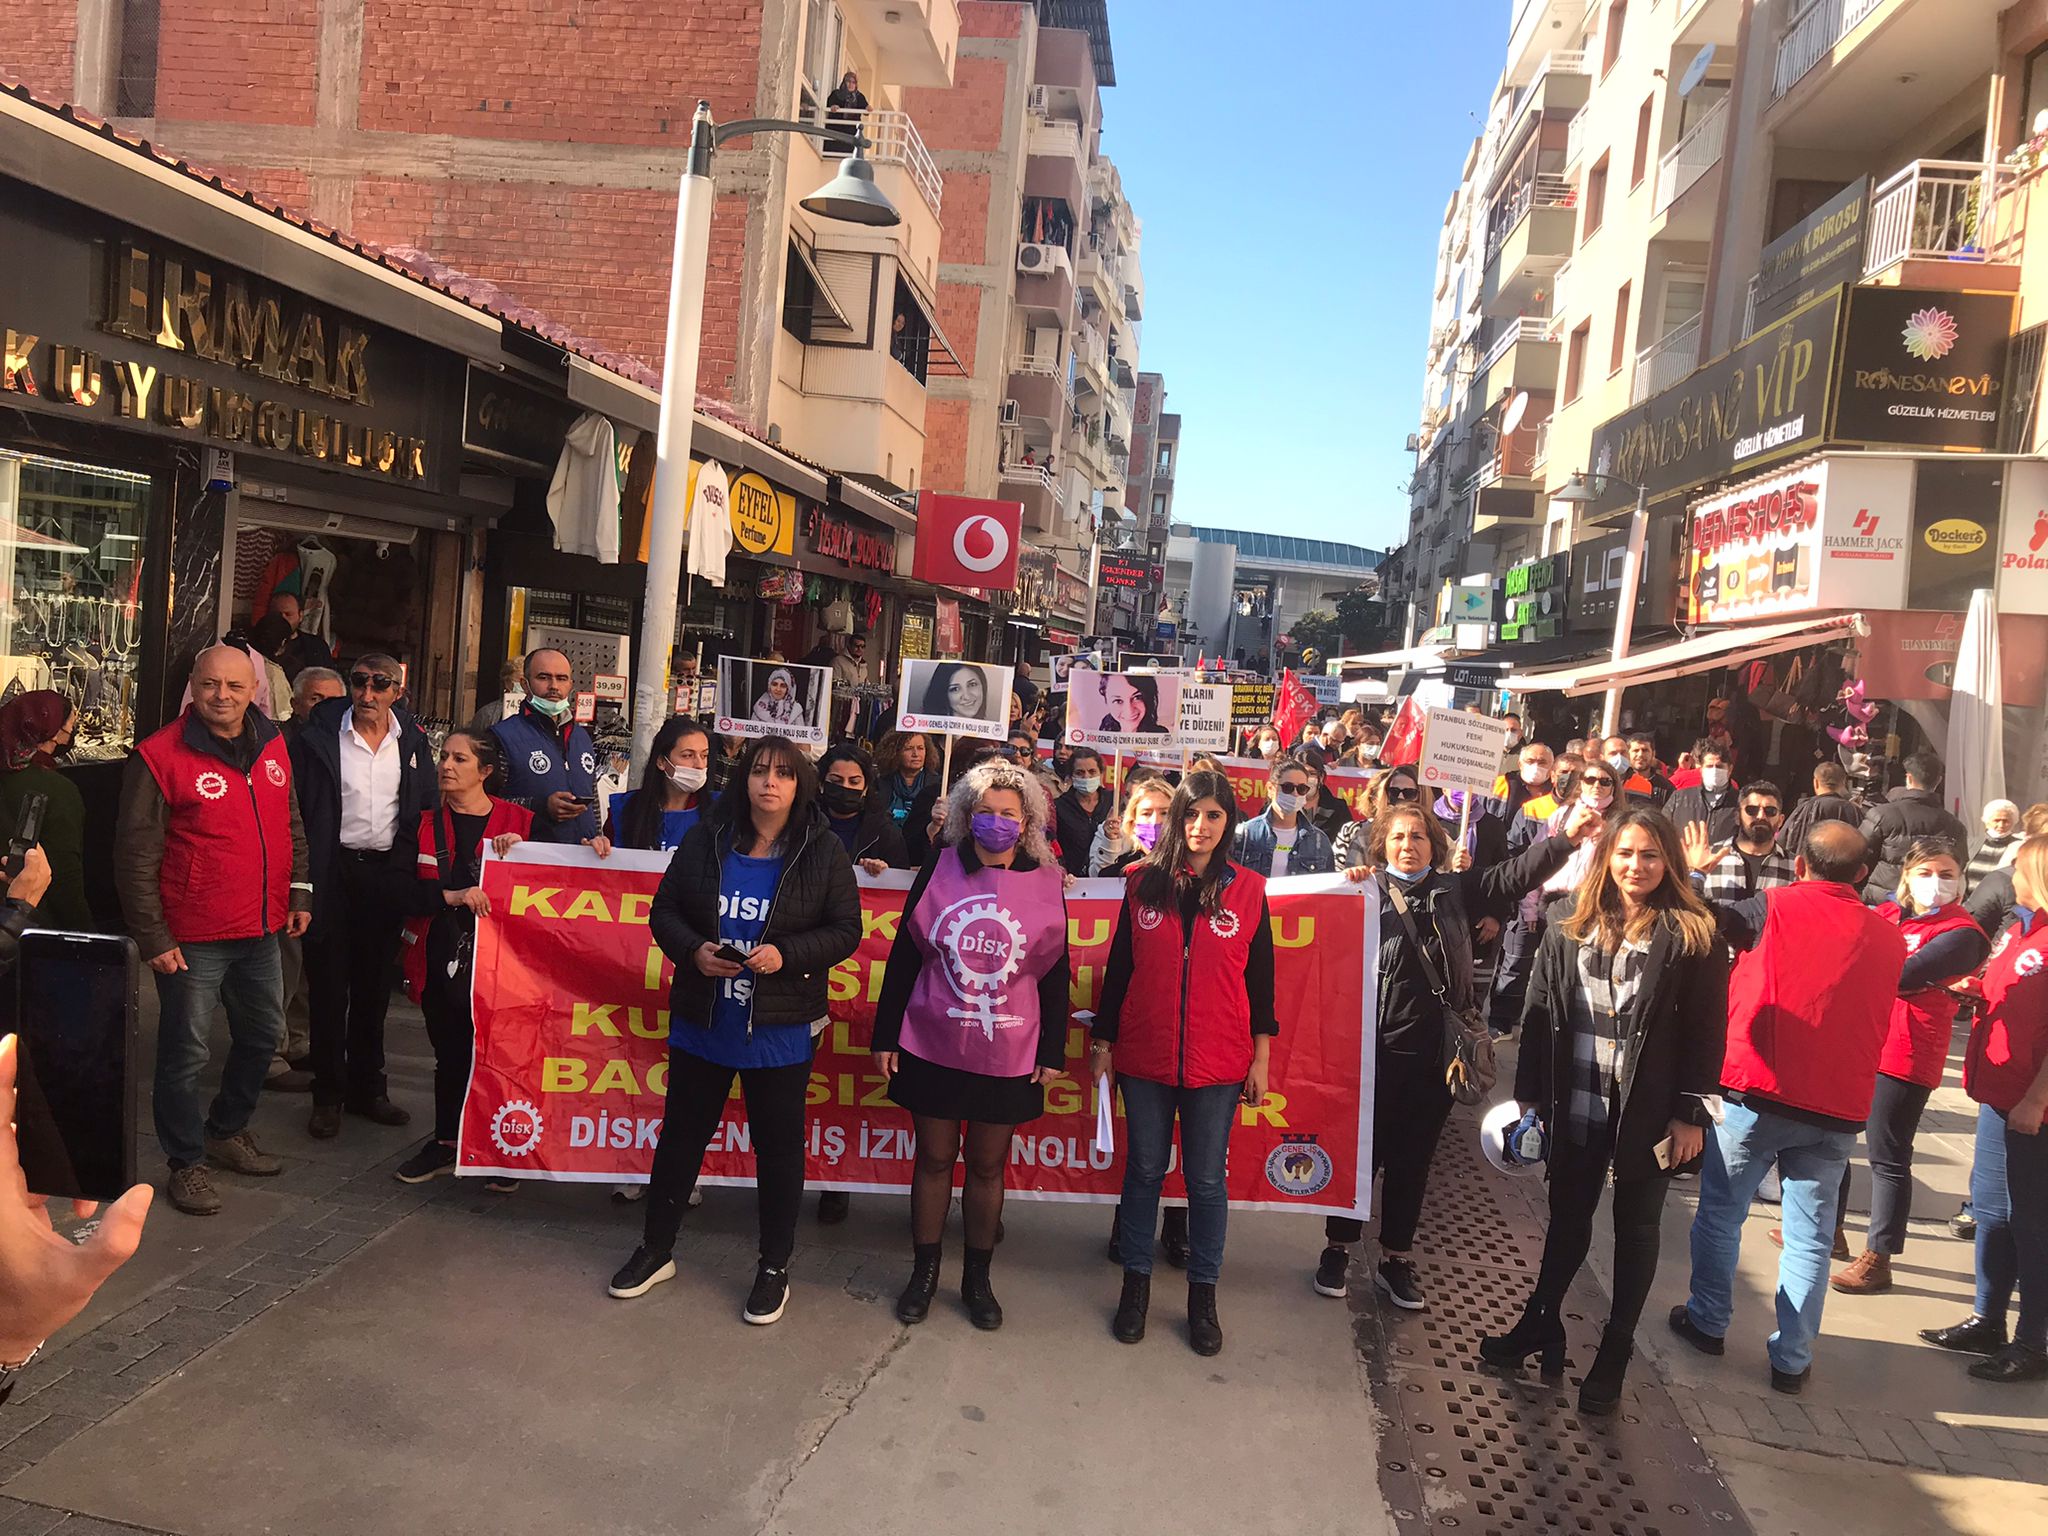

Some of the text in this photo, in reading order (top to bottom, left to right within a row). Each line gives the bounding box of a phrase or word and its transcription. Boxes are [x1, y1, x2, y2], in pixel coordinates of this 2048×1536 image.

[1812, 197, 1861, 250] BÜROSU
[1888, 404, 1996, 422] GÜZELLİK HİZMETLERİ
[738, 482, 774, 526] EYFEL
[1693, 481, 1812, 550] DEFNE SHOES
[741, 521, 767, 546] Perfume
[1824, 535, 1903, 551] HAMMER JACK
[596, 681, 622, 691] 39,99
[1182, 688, 1214, 700] NLARIN
[506, 698, 521, 711] 74,9
[1181, 701, 1201, 715] ATİLİ
[1433, 712, 1467, 725] İSTANBUL
[1433, 752, 1455, 763] KADIN
[961, 930, 1010, 958] DİSK
[502, 1118, 532, 1134] DİSK
[570, 1110, 662, 1149] DİSK
[1011, 1134, 1114, 1171] NOLU
[1282, 1145, 1318, 1154] GENEL-İŞ
